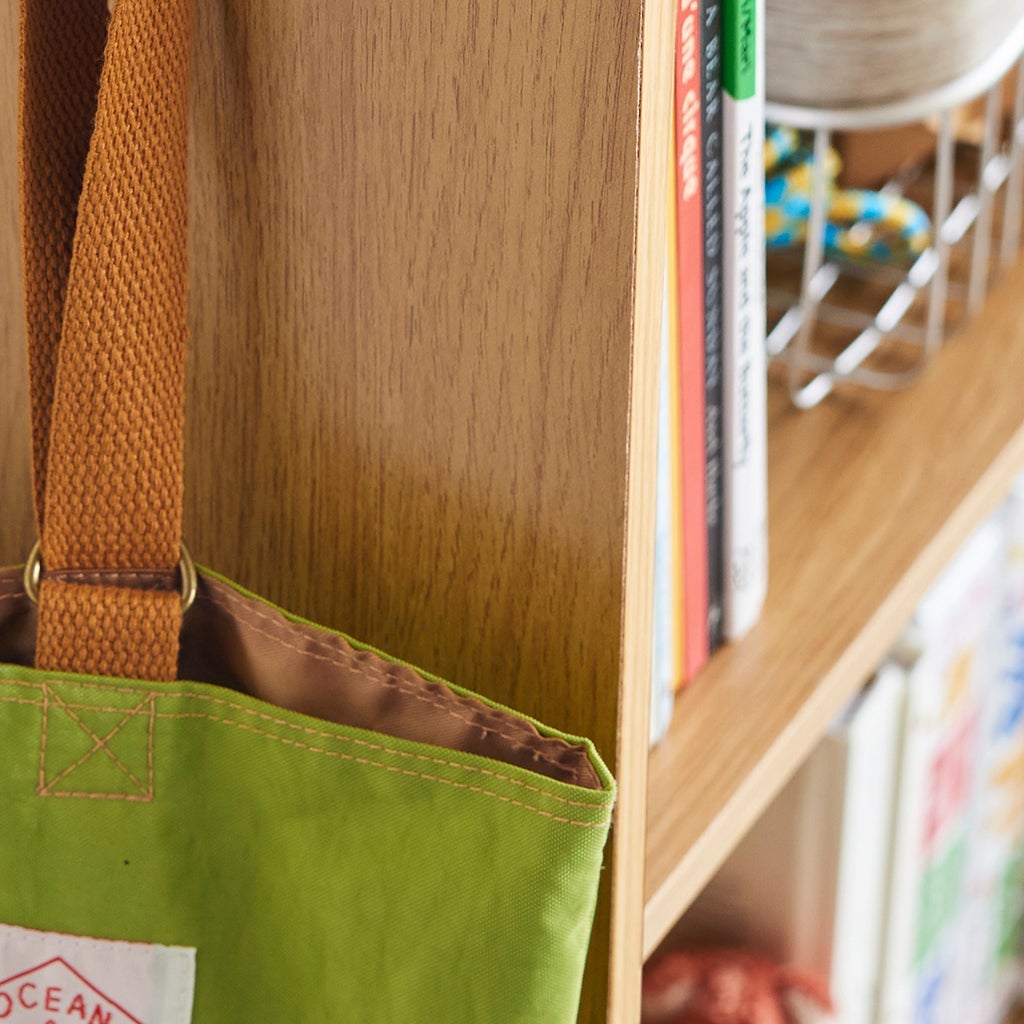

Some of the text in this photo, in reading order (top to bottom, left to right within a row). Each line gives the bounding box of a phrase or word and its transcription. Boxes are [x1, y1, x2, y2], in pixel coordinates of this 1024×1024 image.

[705, 4, 719, 26] A
[705, 36, 719, 123] BEAR
[740, 125, 753, 178] The
[705, 131, 720, 257] CALLED
[735, 187, 751, 257] Apple
